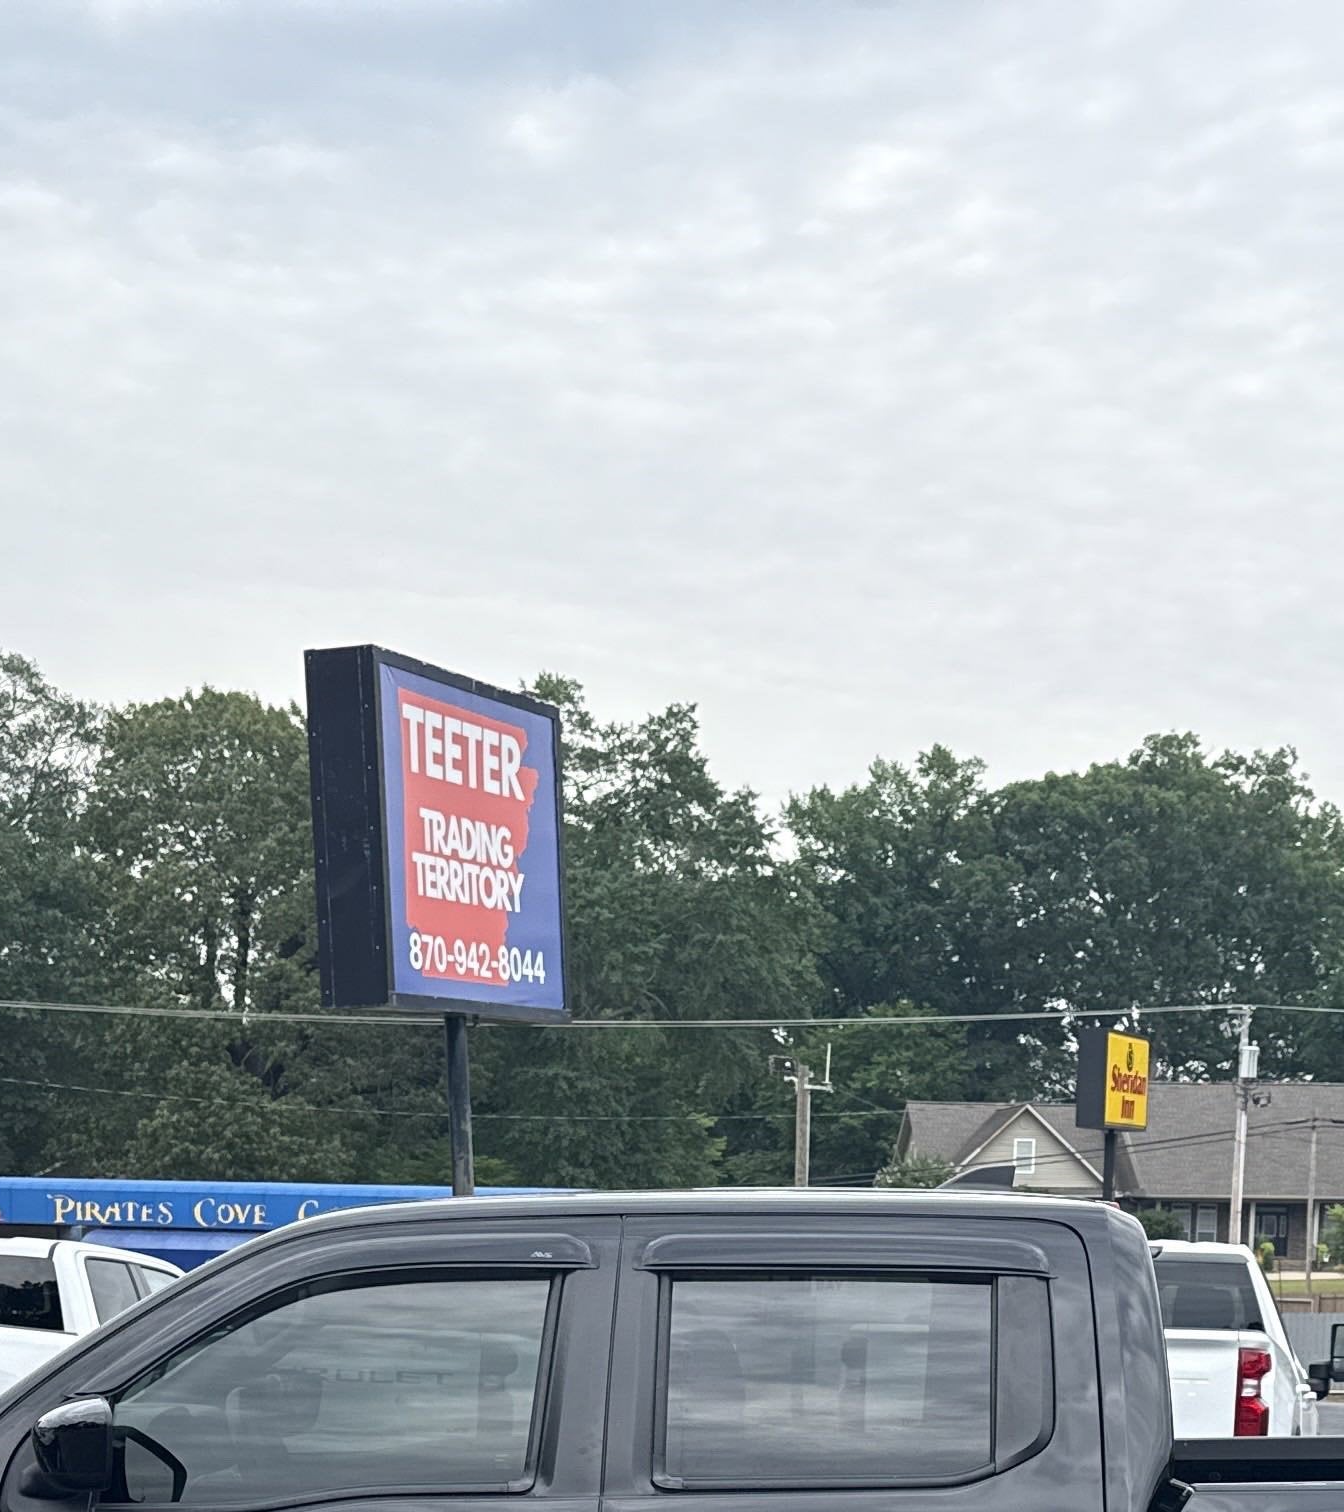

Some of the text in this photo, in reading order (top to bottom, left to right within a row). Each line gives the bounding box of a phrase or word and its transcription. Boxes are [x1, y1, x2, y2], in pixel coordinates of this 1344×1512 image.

[402, 703, 525, 801] TEETER
[419, 807, 514, 868] TRADING
[412, 852, 525, 913] TERRITORY
[409, 932, 546, 984] 870-942-8044
[1111, 1063, 1146, 1096] Sheridan
[1121, 1095, 1135, 1119] Inn
